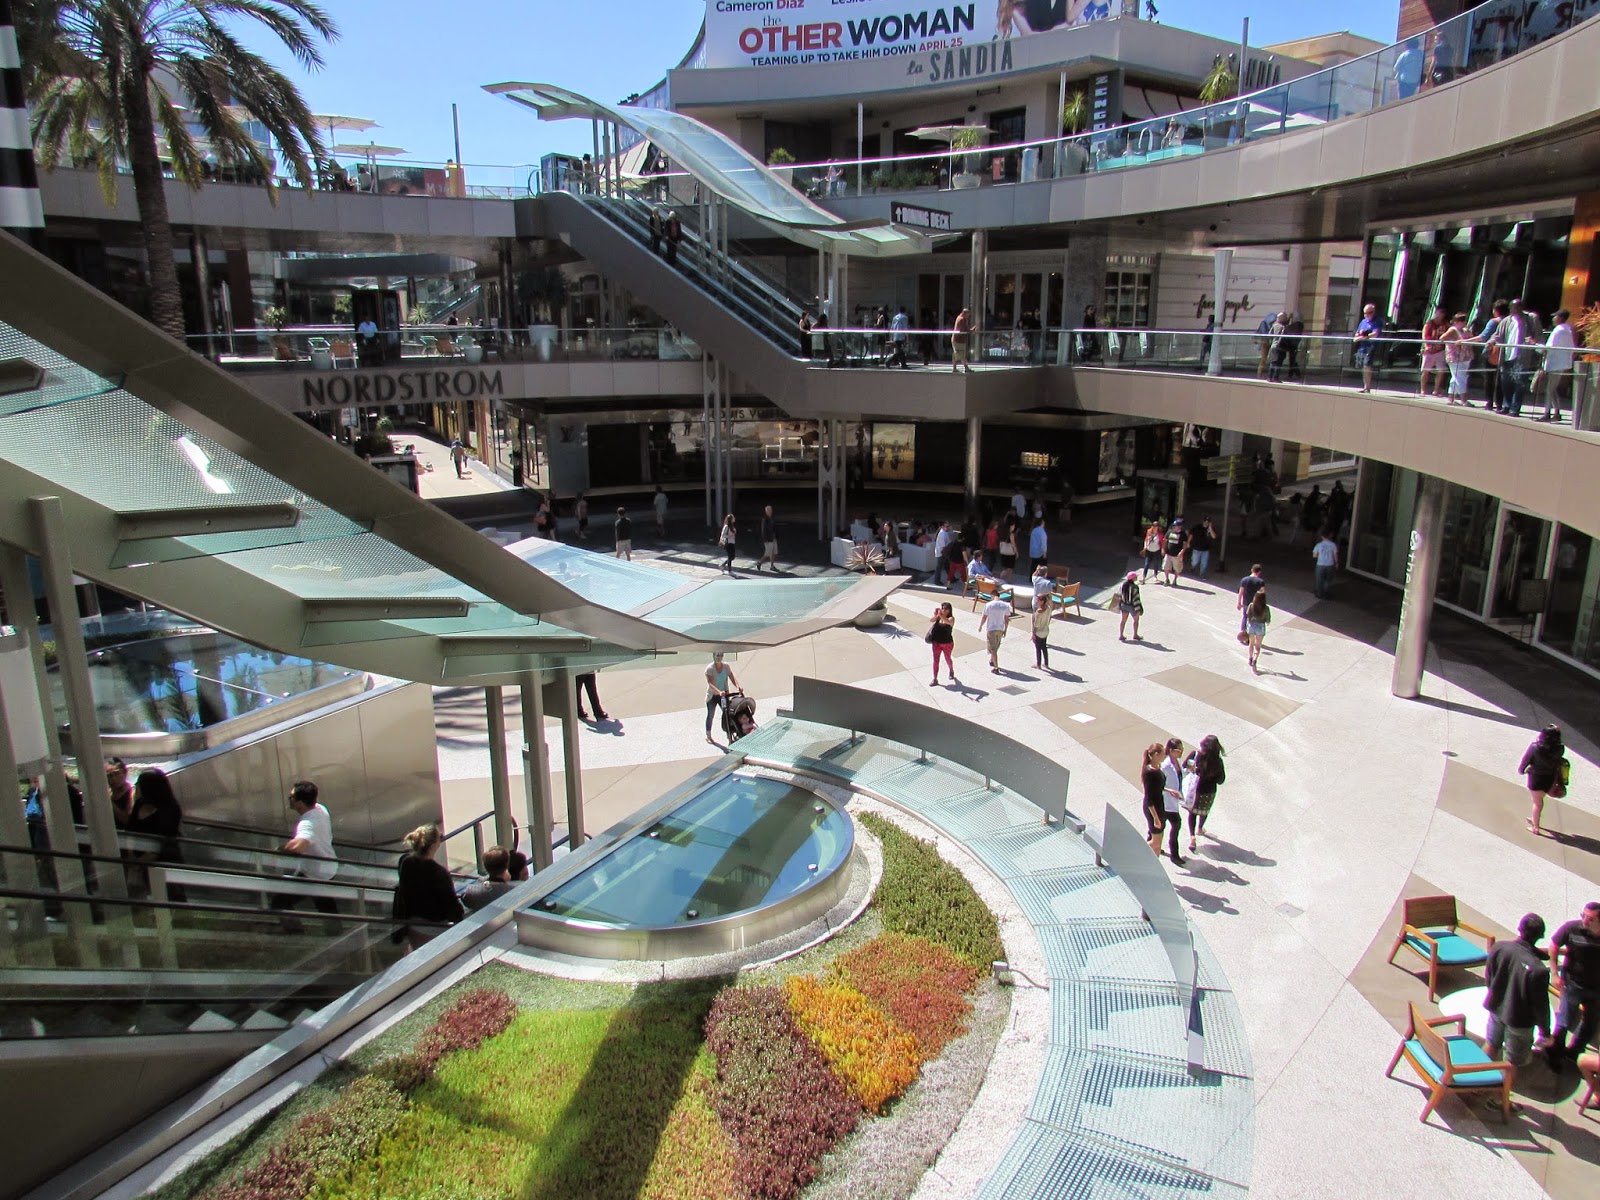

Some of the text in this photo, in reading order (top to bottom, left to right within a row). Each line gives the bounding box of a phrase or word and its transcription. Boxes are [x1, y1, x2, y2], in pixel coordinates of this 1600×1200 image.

[716, 0, 805, 12] Cameron Diaz
[763, 15, 782, 27] the
[739, 4, 975, 54] OTHER WOMAN
[751, 37, 963, 67] TEAMING UP TO TAKE HIM DOWN APRIL 25
[929, 35, 1012, 81] SANDÍA
[303, 370, 504, 406] NORDSTROM
